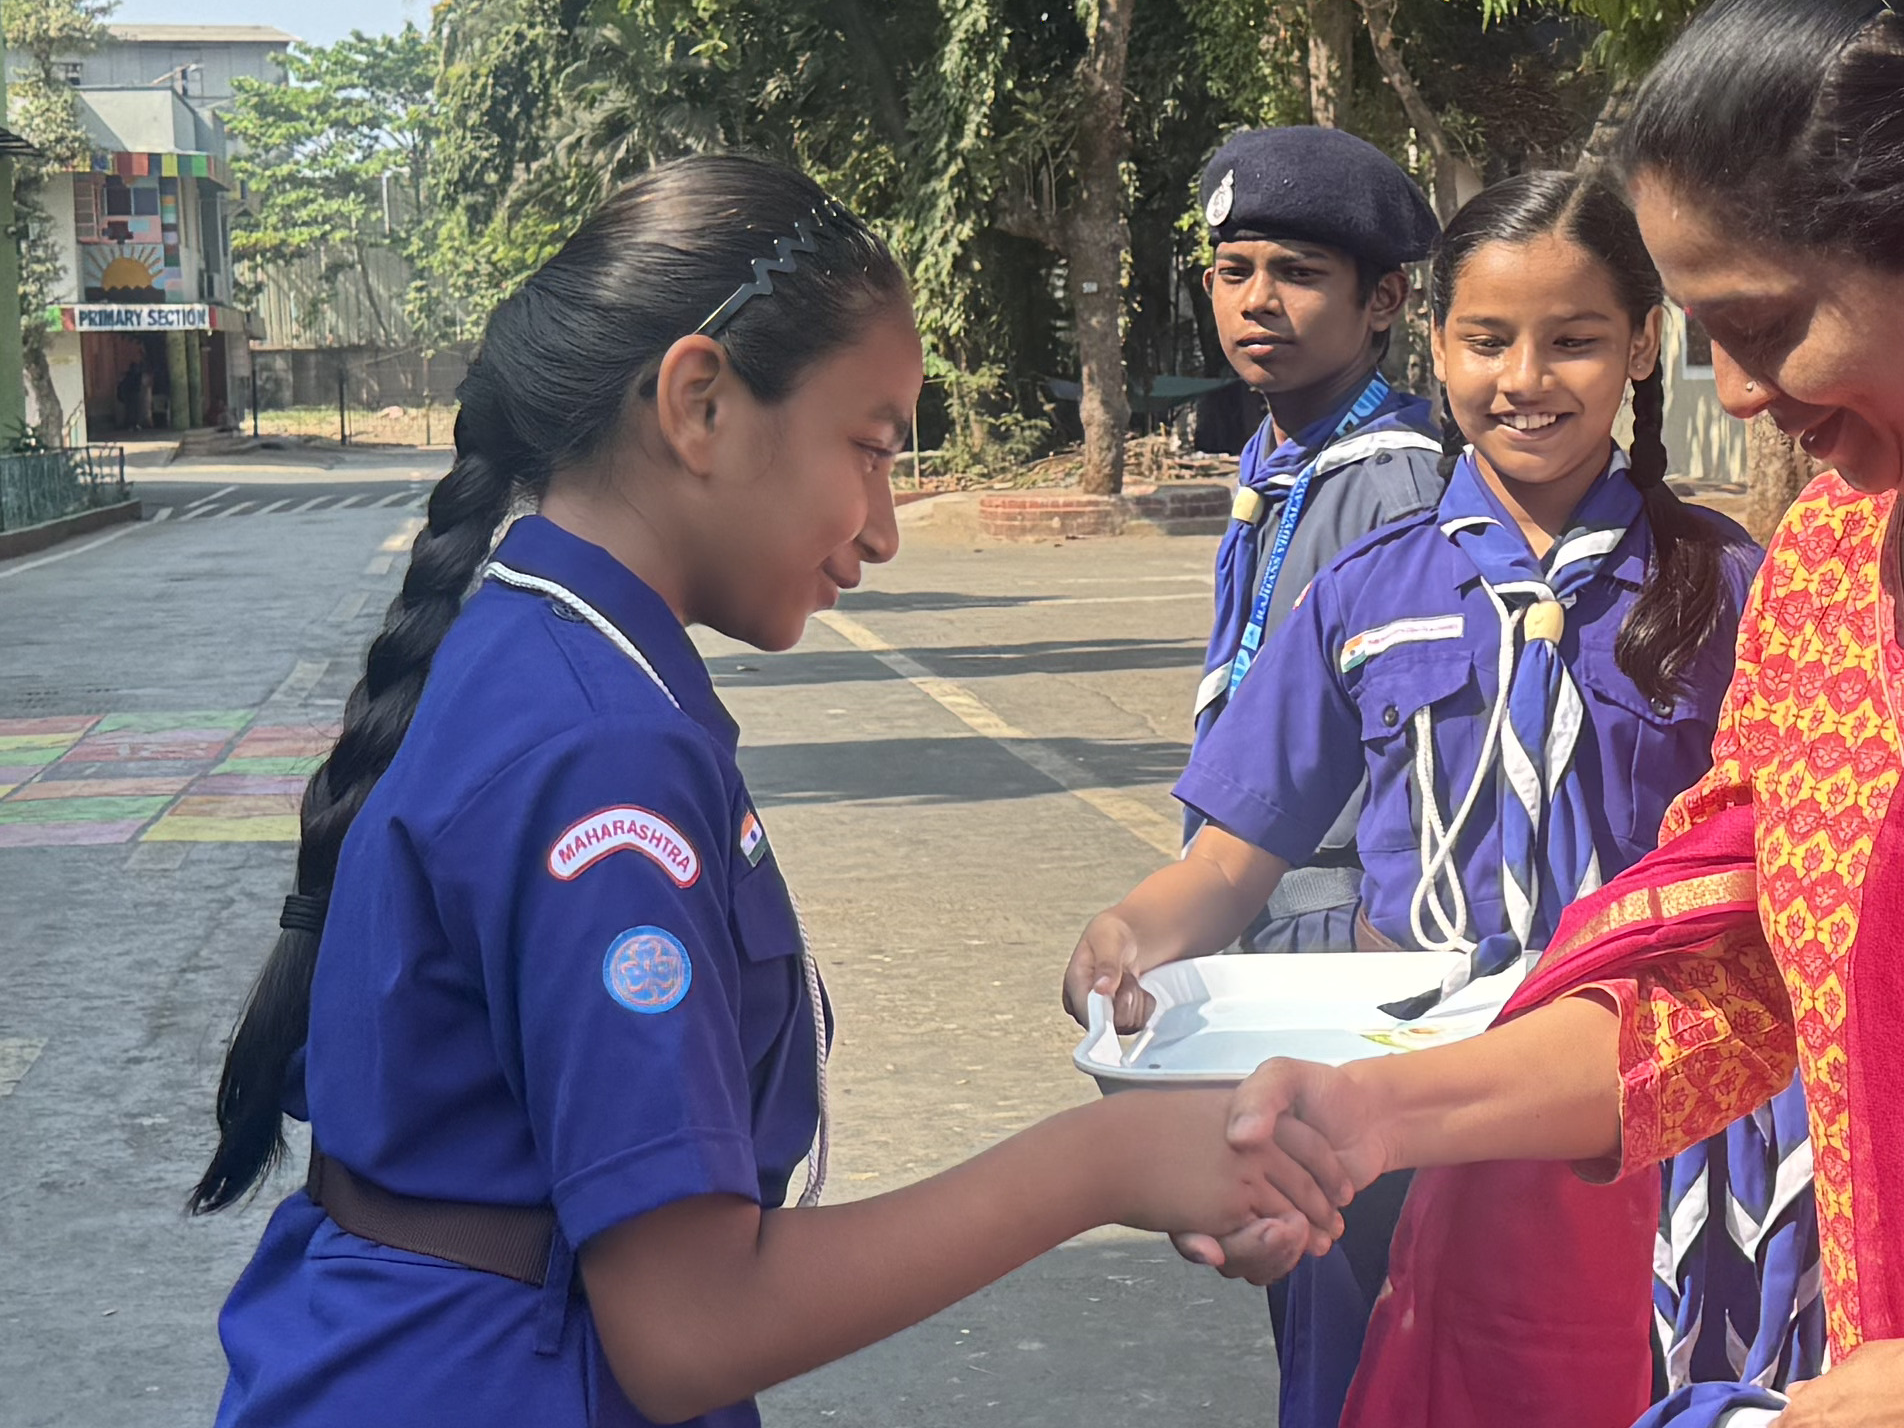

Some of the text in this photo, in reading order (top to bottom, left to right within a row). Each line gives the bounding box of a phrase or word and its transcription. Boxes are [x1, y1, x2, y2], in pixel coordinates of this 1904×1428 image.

[79, 309, 206, 327] PRIMARY SECTION
[558, 819, 690, 874] MAHARASHTRA
